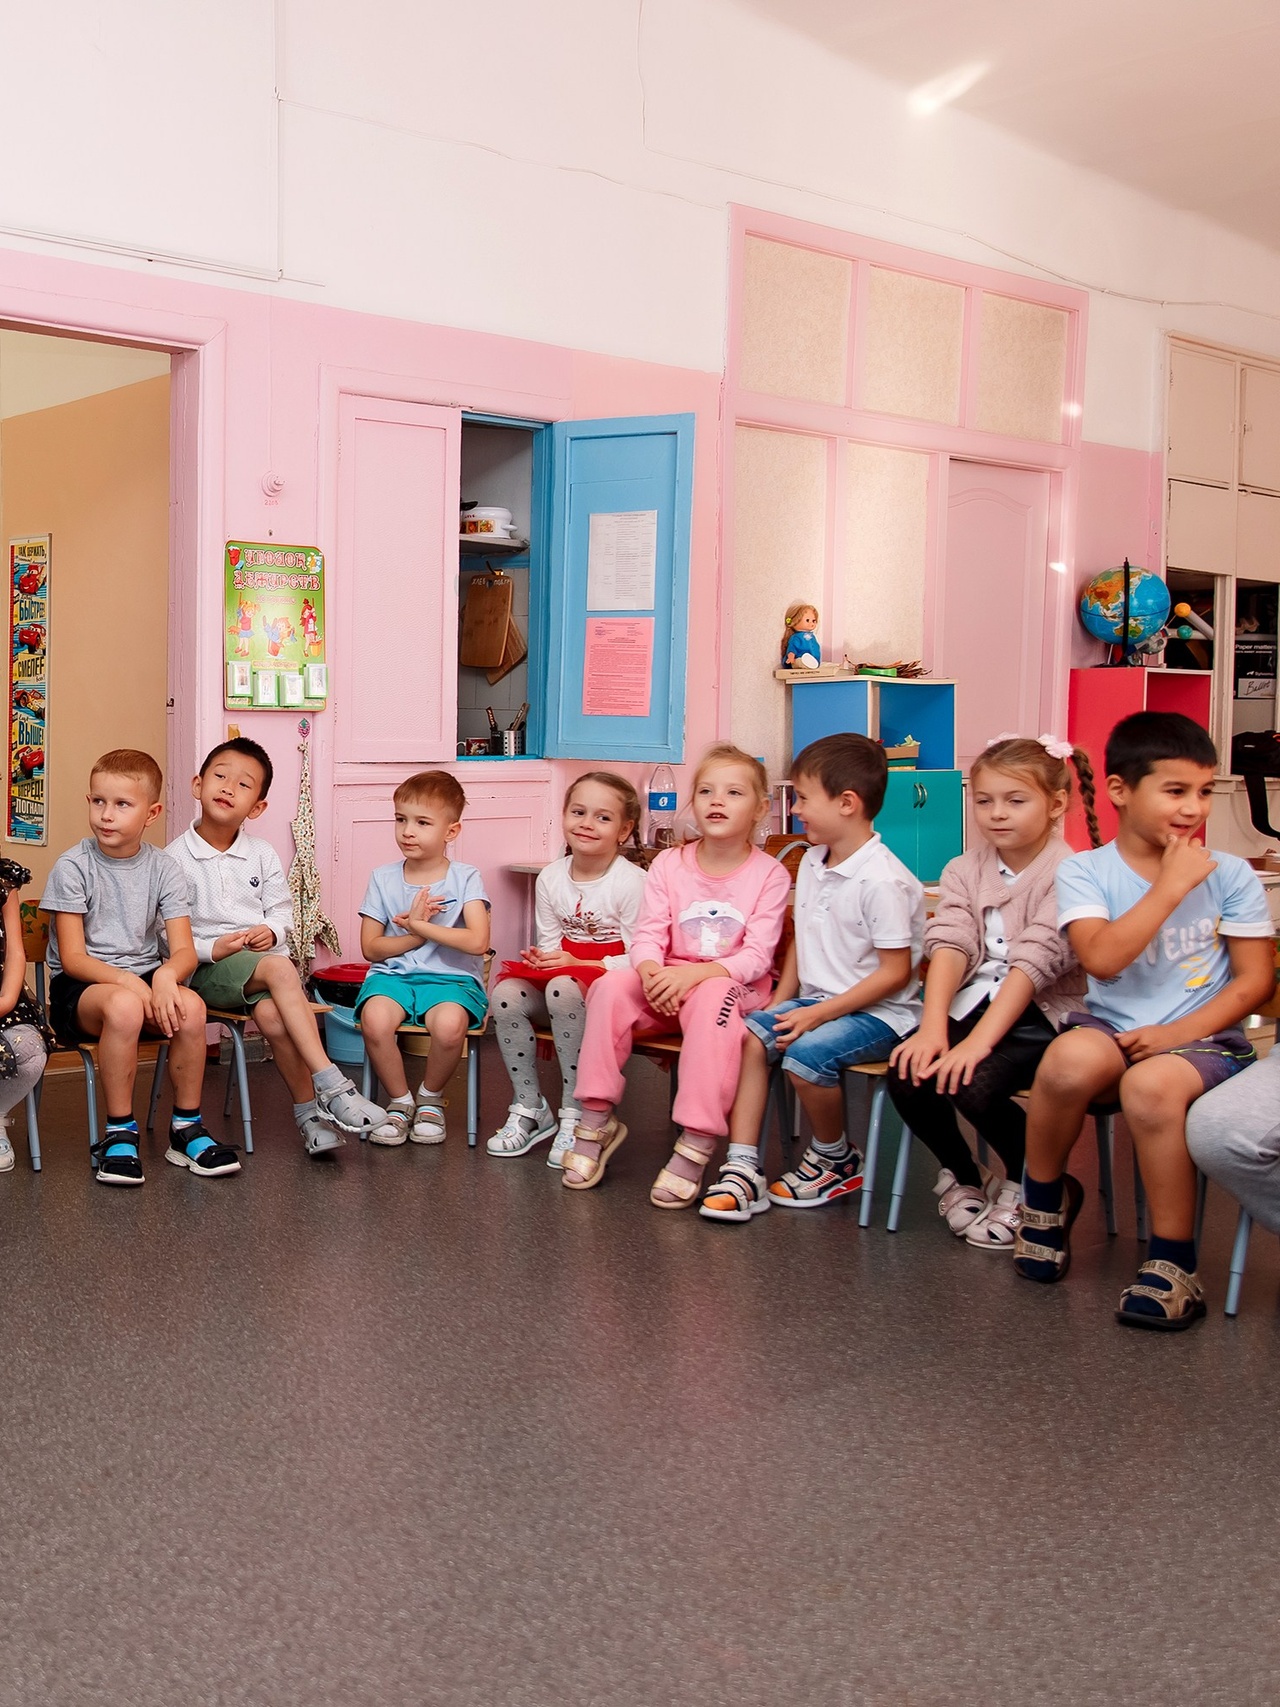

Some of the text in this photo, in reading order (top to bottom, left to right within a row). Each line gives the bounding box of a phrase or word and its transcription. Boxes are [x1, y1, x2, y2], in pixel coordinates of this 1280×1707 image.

[244, 548, 307, 571] УГОЛОК
[233, 570, 321, 591] ДЕЖУРСТВ
[18, 721, 44, 745] ВЫШЕ!
[18, 779, 44, 800] ВПЕРЕД!
